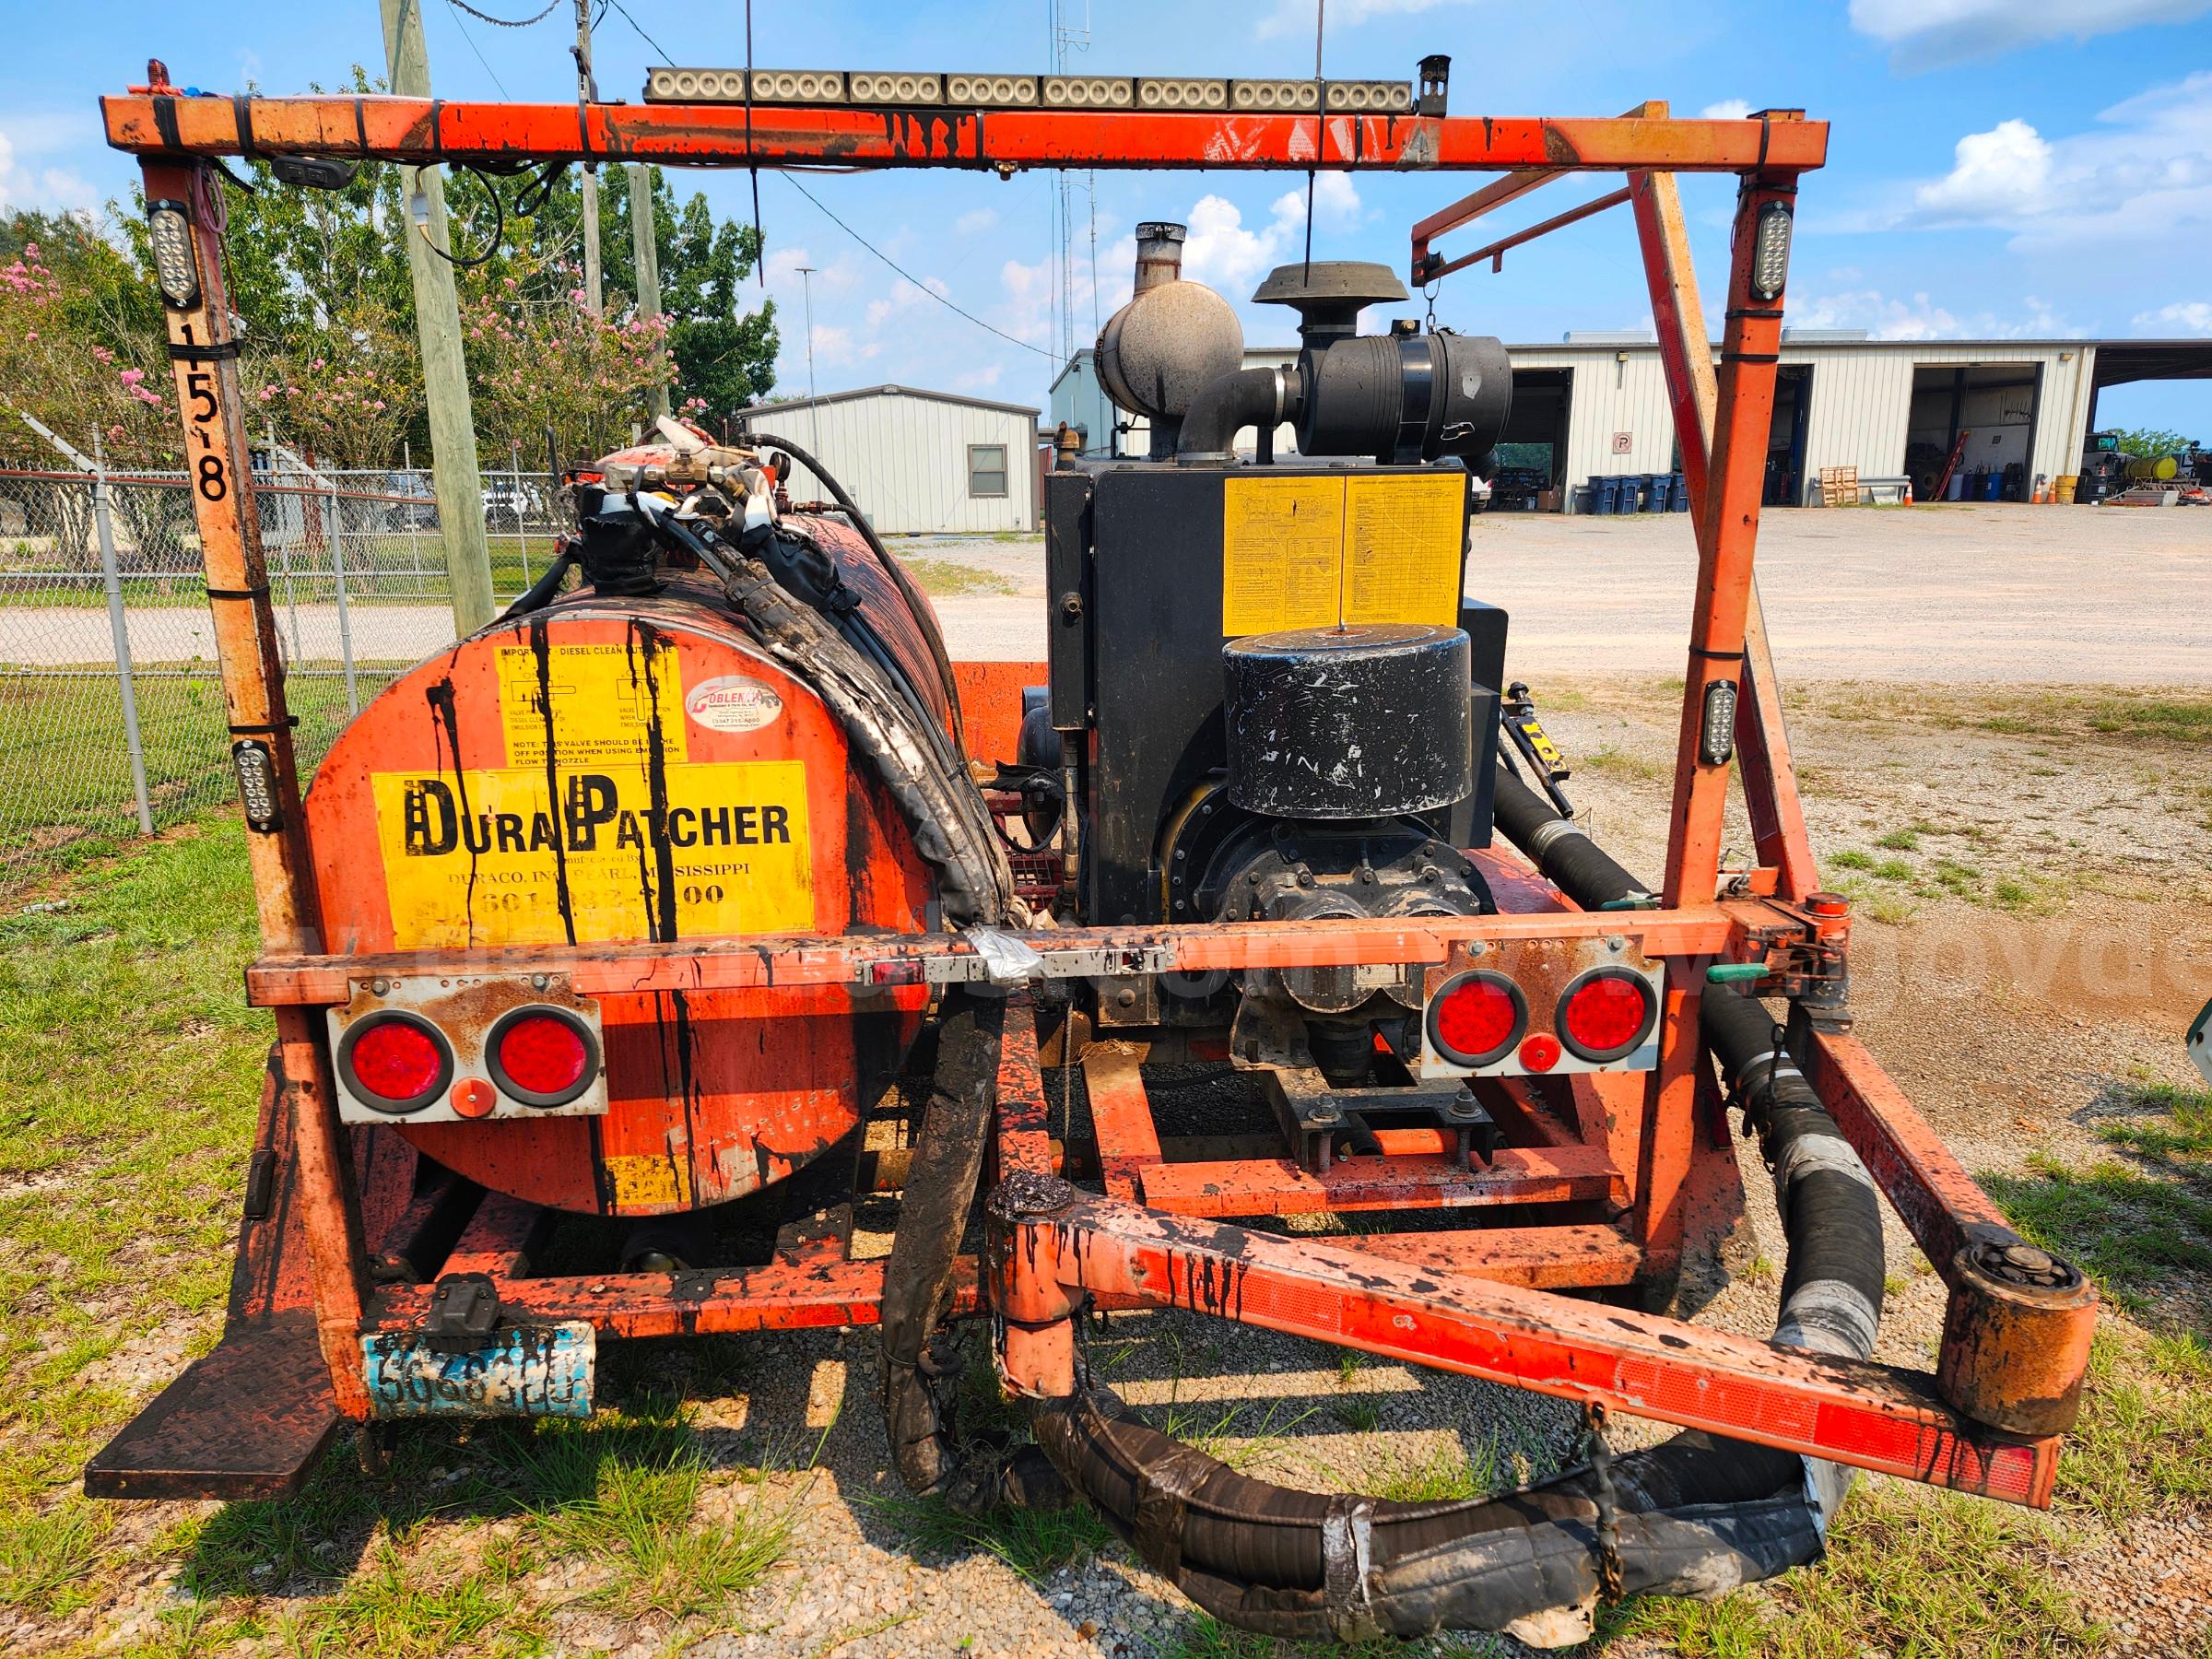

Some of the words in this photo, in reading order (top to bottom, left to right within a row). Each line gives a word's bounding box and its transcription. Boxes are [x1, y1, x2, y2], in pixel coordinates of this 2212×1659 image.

[501, 647, 551, 656] IMPORT
[560, 647, 591, 655] DIESEL
[594, 646, 622, 654] CLEAN
[404, 779, 554, 856] DURA
[643, 864, 750, 877] MSISSIPPI
